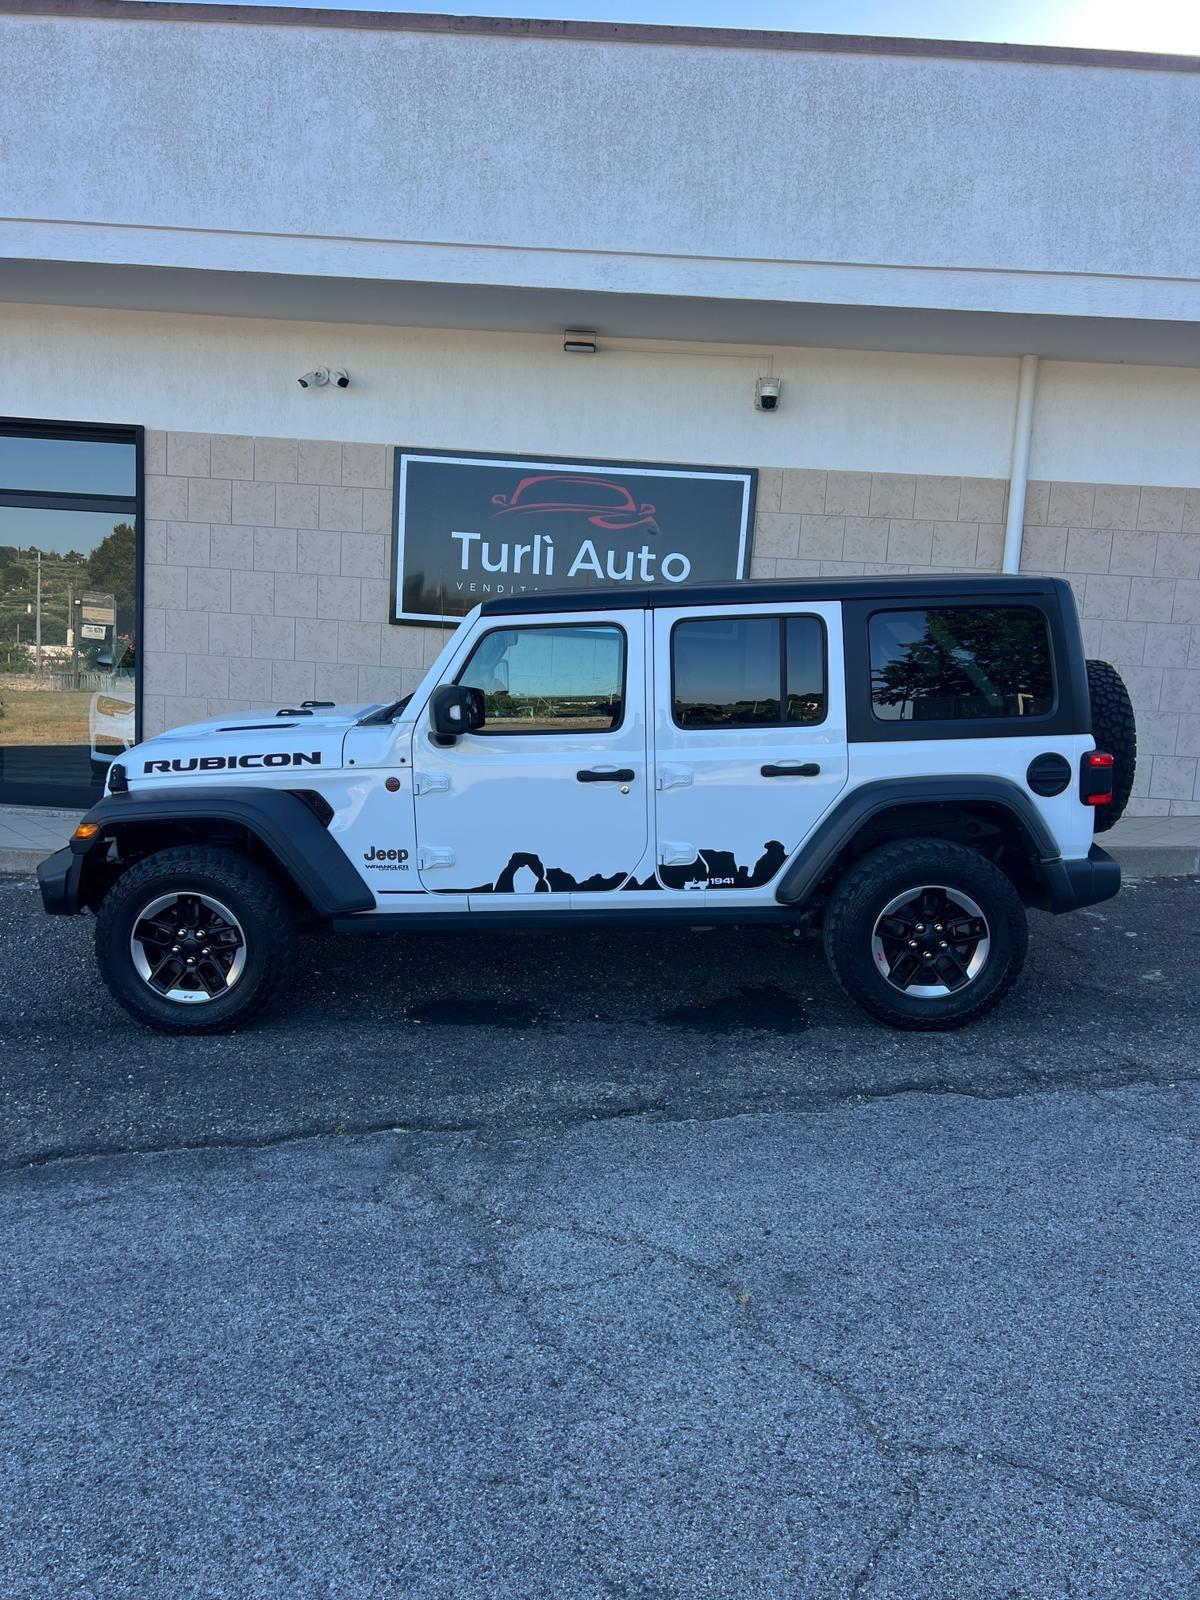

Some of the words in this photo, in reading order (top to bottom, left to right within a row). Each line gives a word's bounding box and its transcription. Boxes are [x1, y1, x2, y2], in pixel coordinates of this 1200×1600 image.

[451, 531, 555, 576] Turlì
[567, 538, 692, 583] Auto
[456, 582, 538, 594] VENDIT
[143, 751, 322, 774] RUBICON
[363, 846, 409, 863] Jeep
[710, 877, 734, 885] 1941
